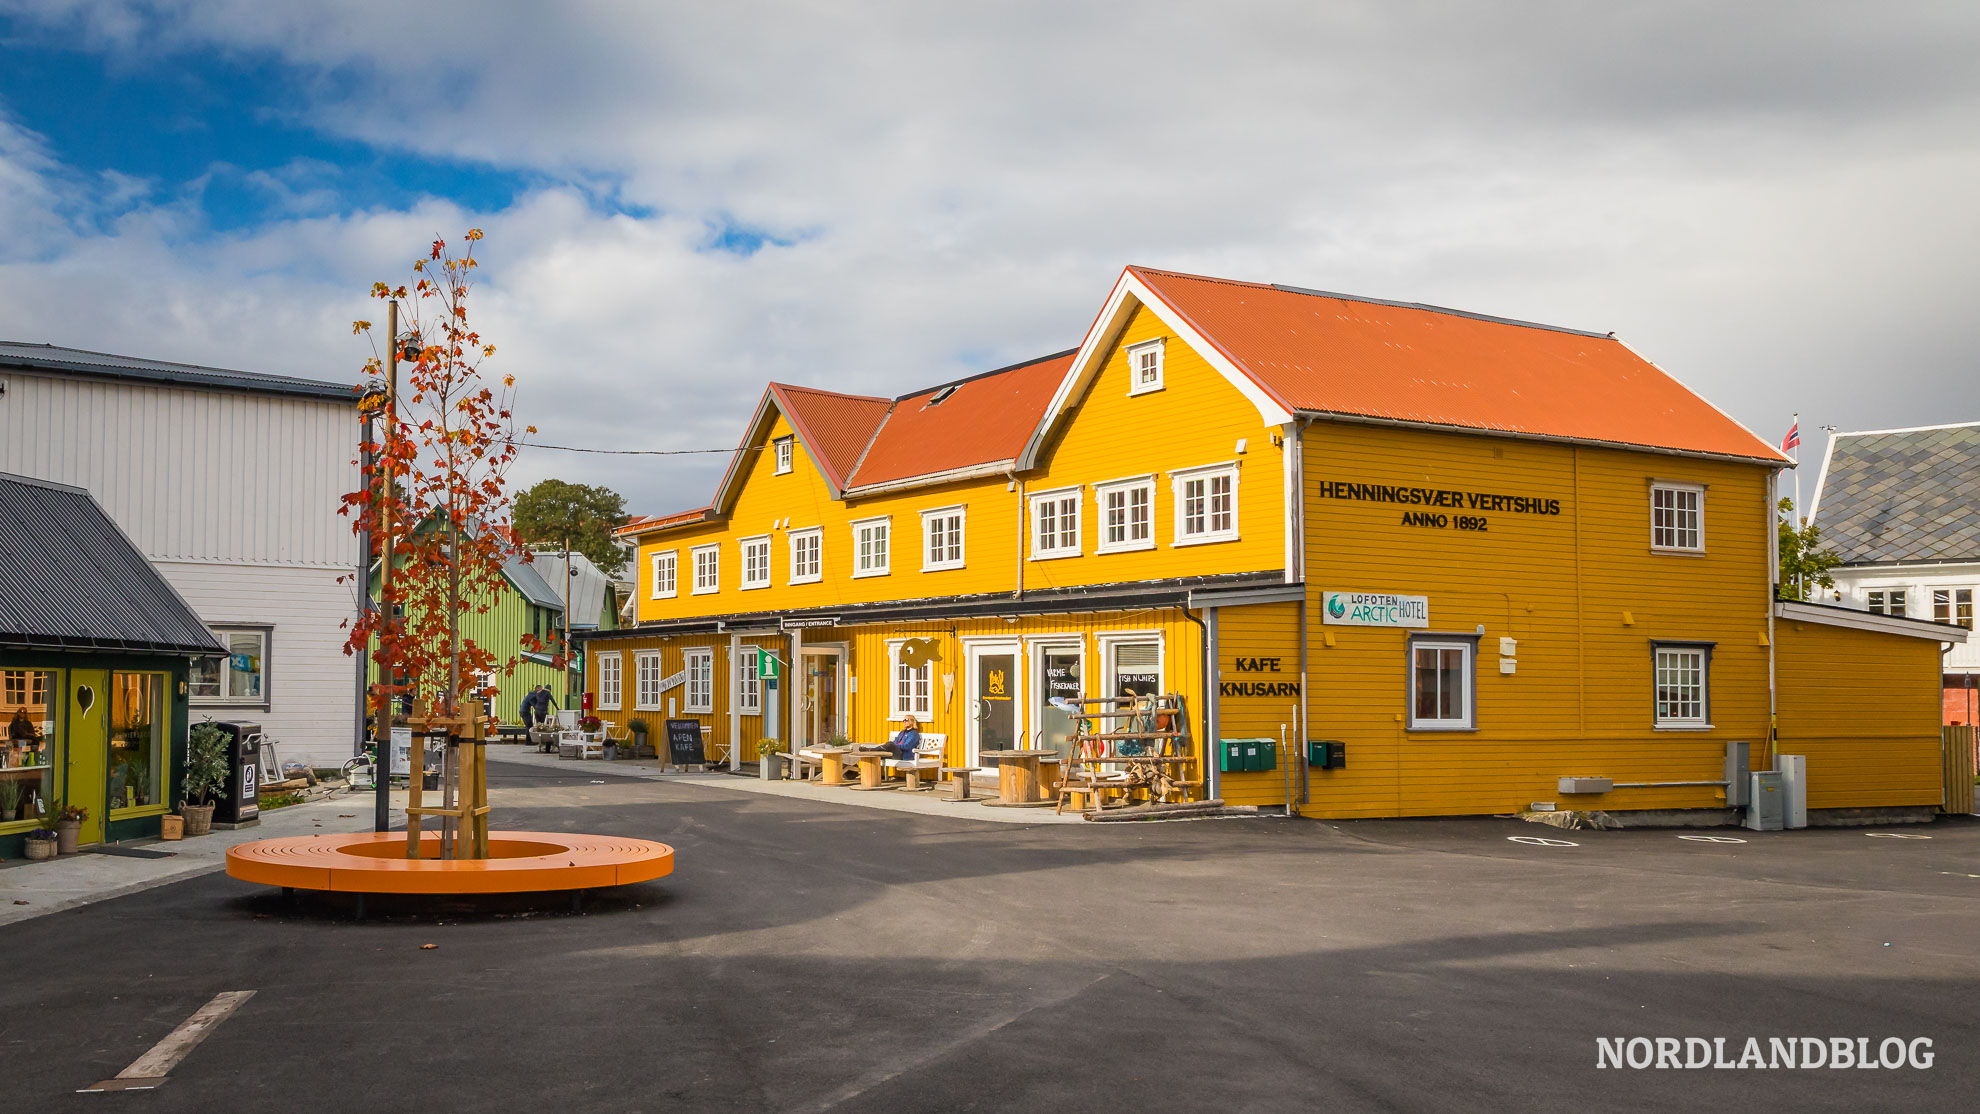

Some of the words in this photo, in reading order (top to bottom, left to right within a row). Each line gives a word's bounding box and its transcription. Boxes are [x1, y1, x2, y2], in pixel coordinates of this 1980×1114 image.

[1320, 480, 1464, 508] HENNINGSVÆR
[1466, 492, 1560, 515] VERTSHUS
[1401, 512, 1448, 528] ANNO
[1452, 515, 1488, 531] 1892
[1351, 594, 1397, 605] LOFOTEN
[1350, 605, 1398, 623] ARCTIC
[1399, 600, 1426, 619] HOTEL
[1235, 657, 1281, 671] KAFE
[1219, 682, 1300, 696] KNUSARN
[675, 743, 694, 751] KAFE
